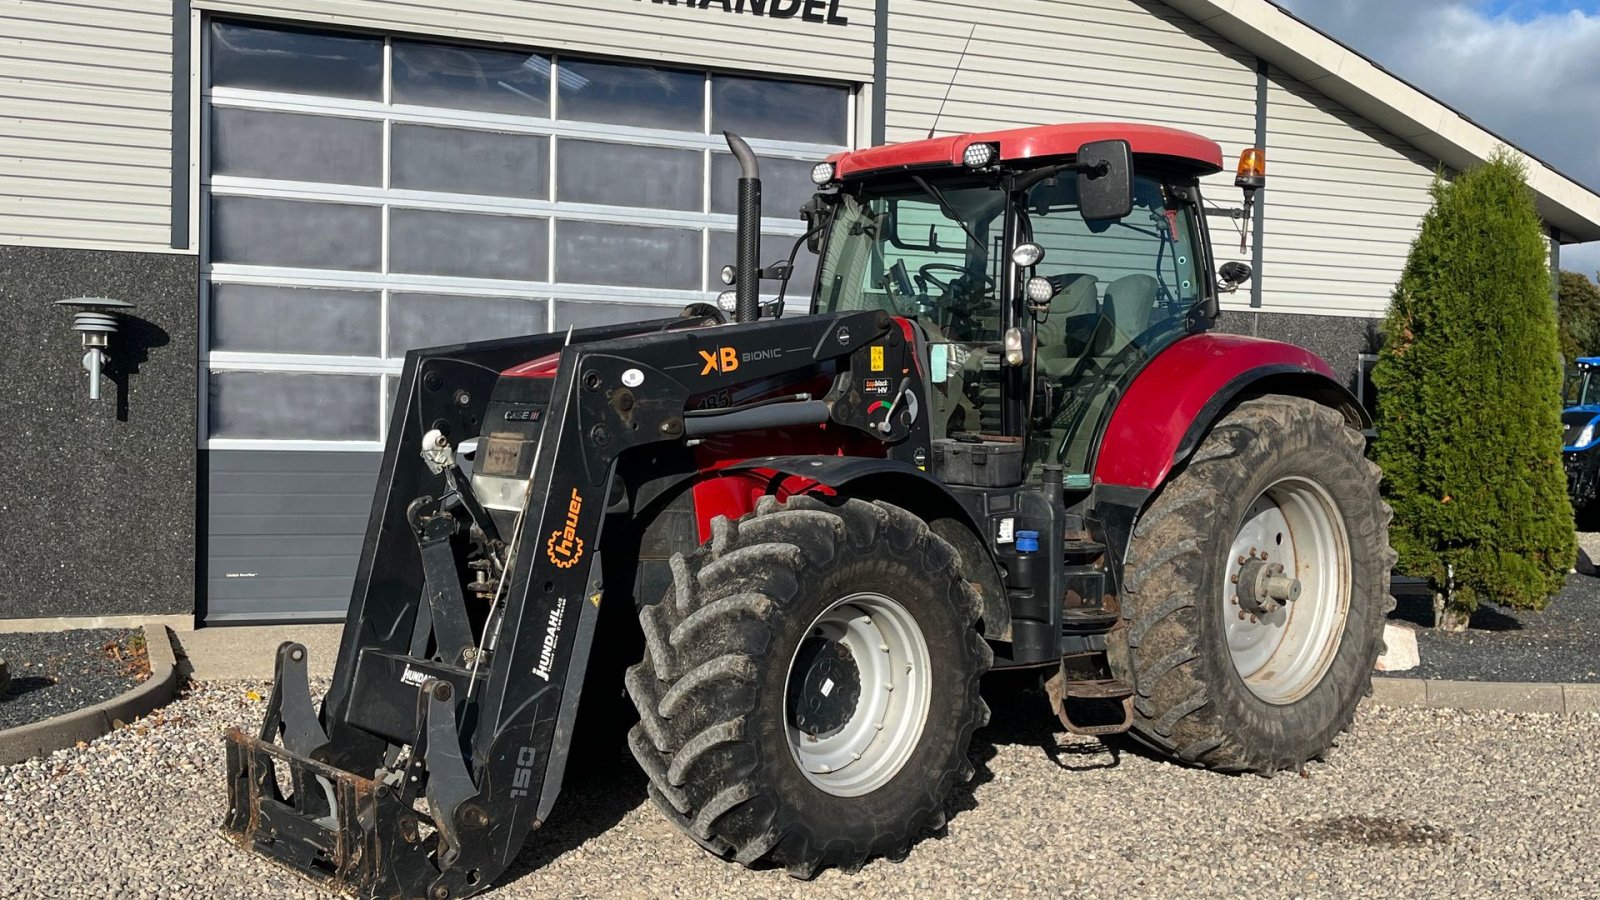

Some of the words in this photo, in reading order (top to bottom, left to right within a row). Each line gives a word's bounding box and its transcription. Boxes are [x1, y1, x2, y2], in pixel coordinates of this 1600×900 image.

[742, 348, 782, 362] BIONIC
[504, 411, 529, 420] CASE
[555, 488, 582, 557] hauer
[510, 746, 536, 798] 150
